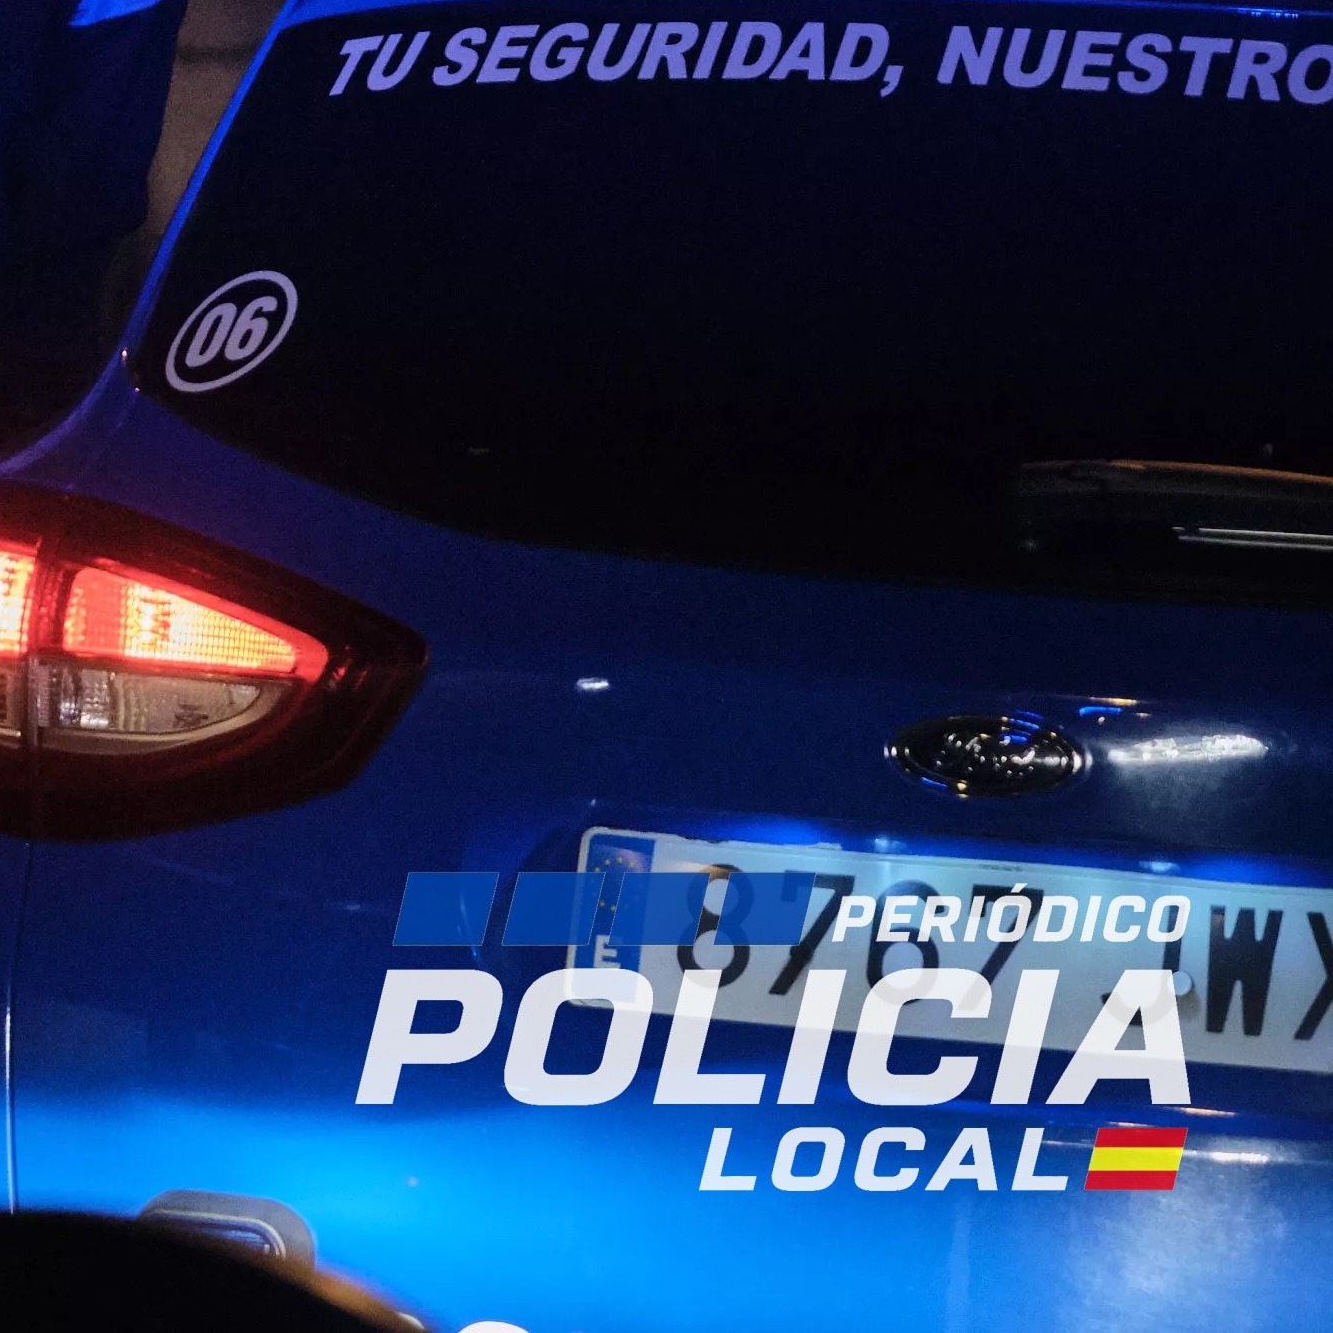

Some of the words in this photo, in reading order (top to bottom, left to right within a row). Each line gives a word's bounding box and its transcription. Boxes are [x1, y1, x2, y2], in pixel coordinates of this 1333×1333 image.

[329, 31, 431, 97] TU
[433, 21, 903, 97] SEGURIDAD,
[936, 25, 1333, 105] NUESTRO
[184, 295, 279, 369] 06
